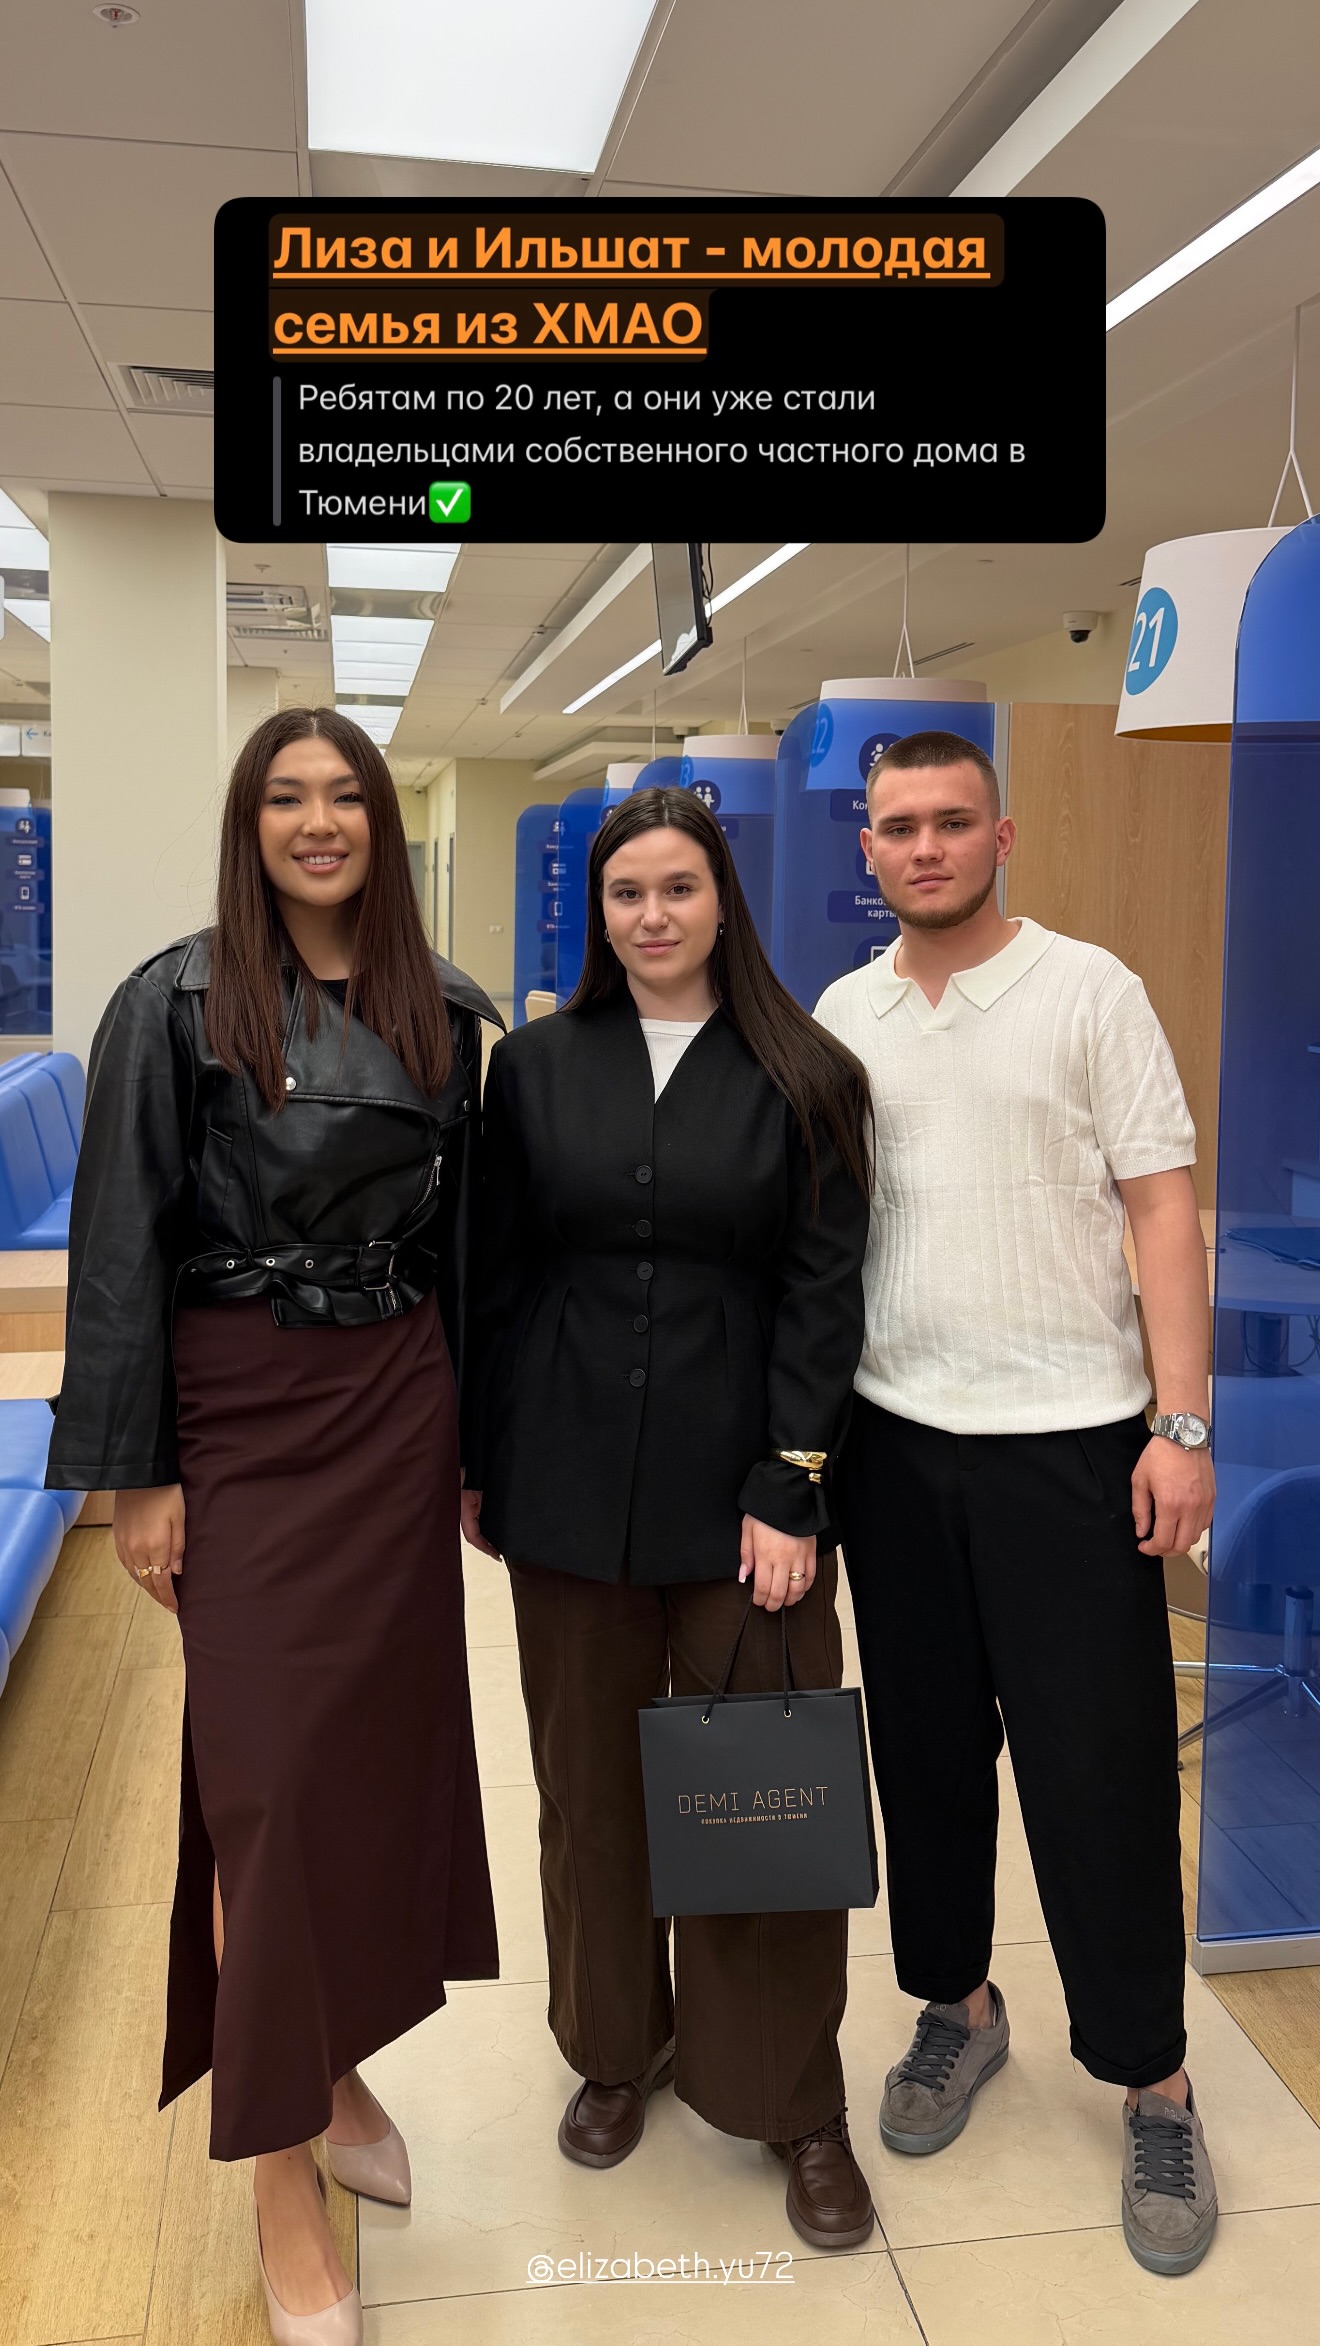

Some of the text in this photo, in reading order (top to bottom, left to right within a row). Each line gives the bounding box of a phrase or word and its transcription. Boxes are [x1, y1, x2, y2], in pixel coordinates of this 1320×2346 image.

[1127, 607, 1165, 672] 21
[855, 895, 887, 906] Банко
[678, 1786, 829, 1814] DEMI AGENT
